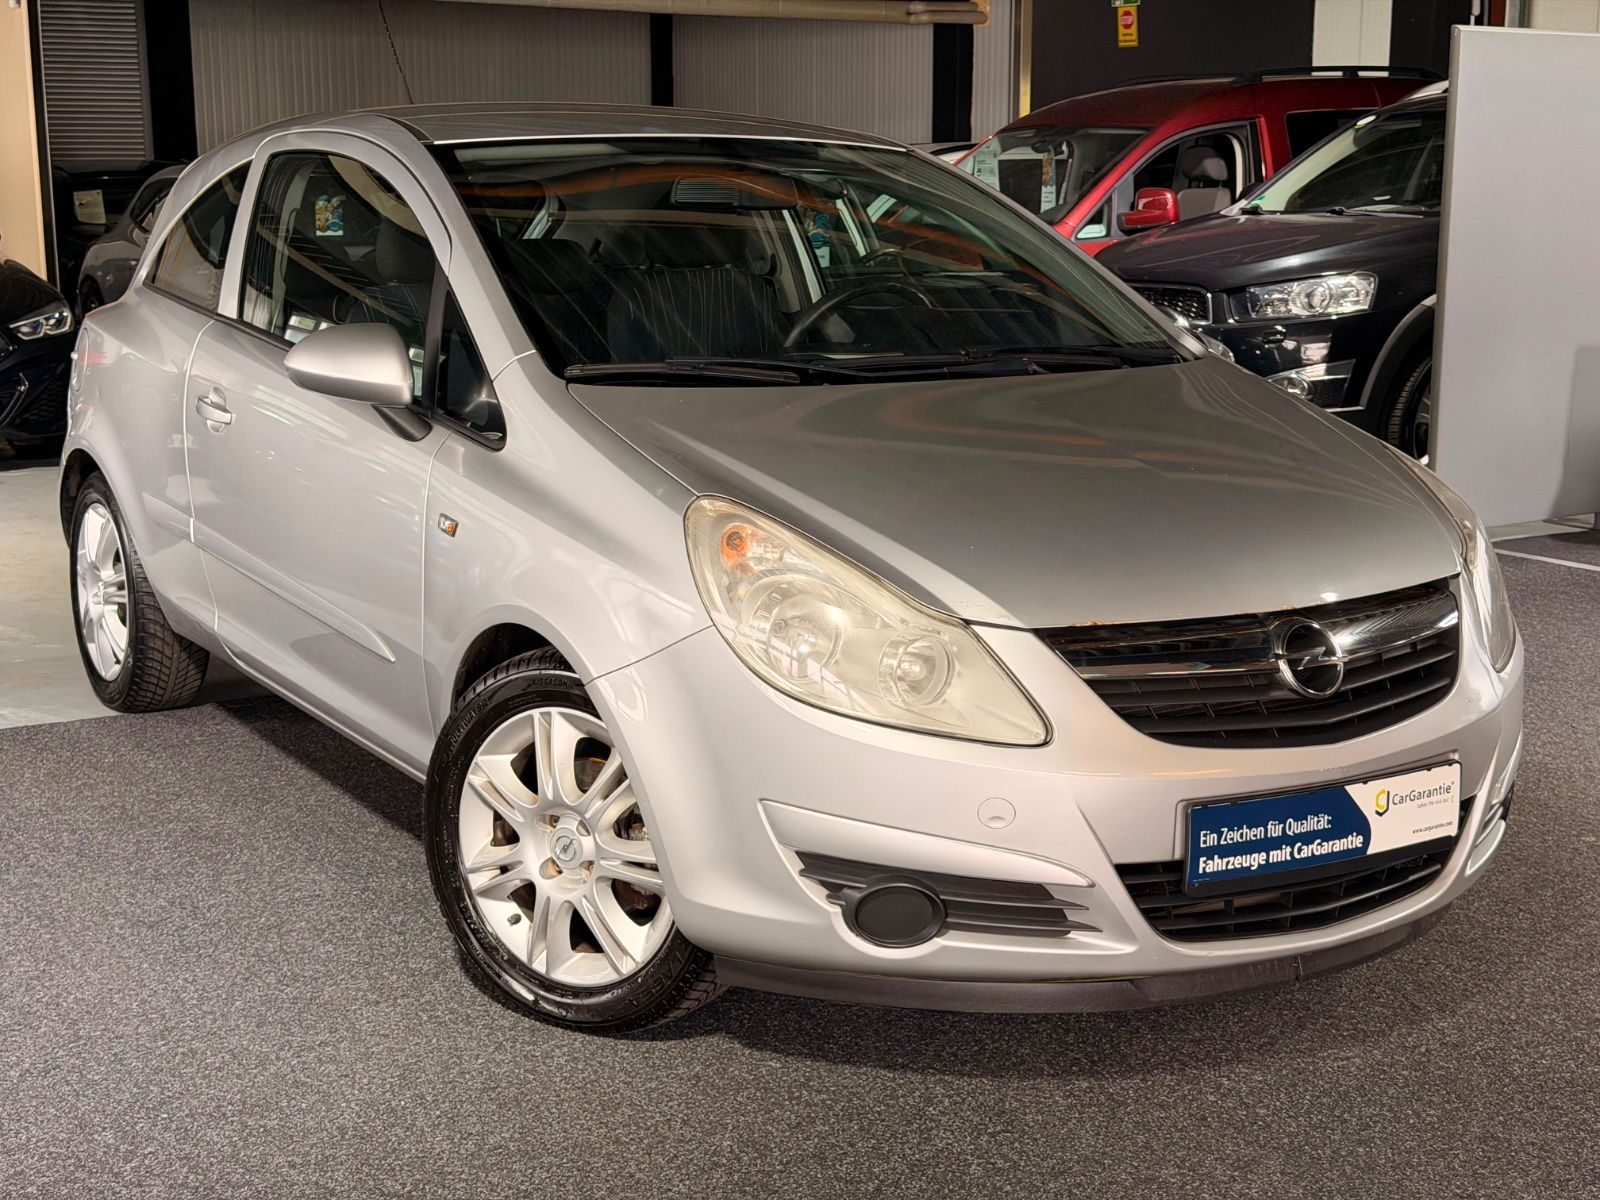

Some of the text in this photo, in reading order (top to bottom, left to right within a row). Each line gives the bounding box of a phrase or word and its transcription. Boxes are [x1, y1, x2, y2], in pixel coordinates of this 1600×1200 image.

[1392, 782, 1451, 806] CarGarantie
[1200, 813, 1332, 848] Ein Zeichen für Qualität:
[1198, 831, 1364, 874] Fahrzeuge mit CarGarantie
